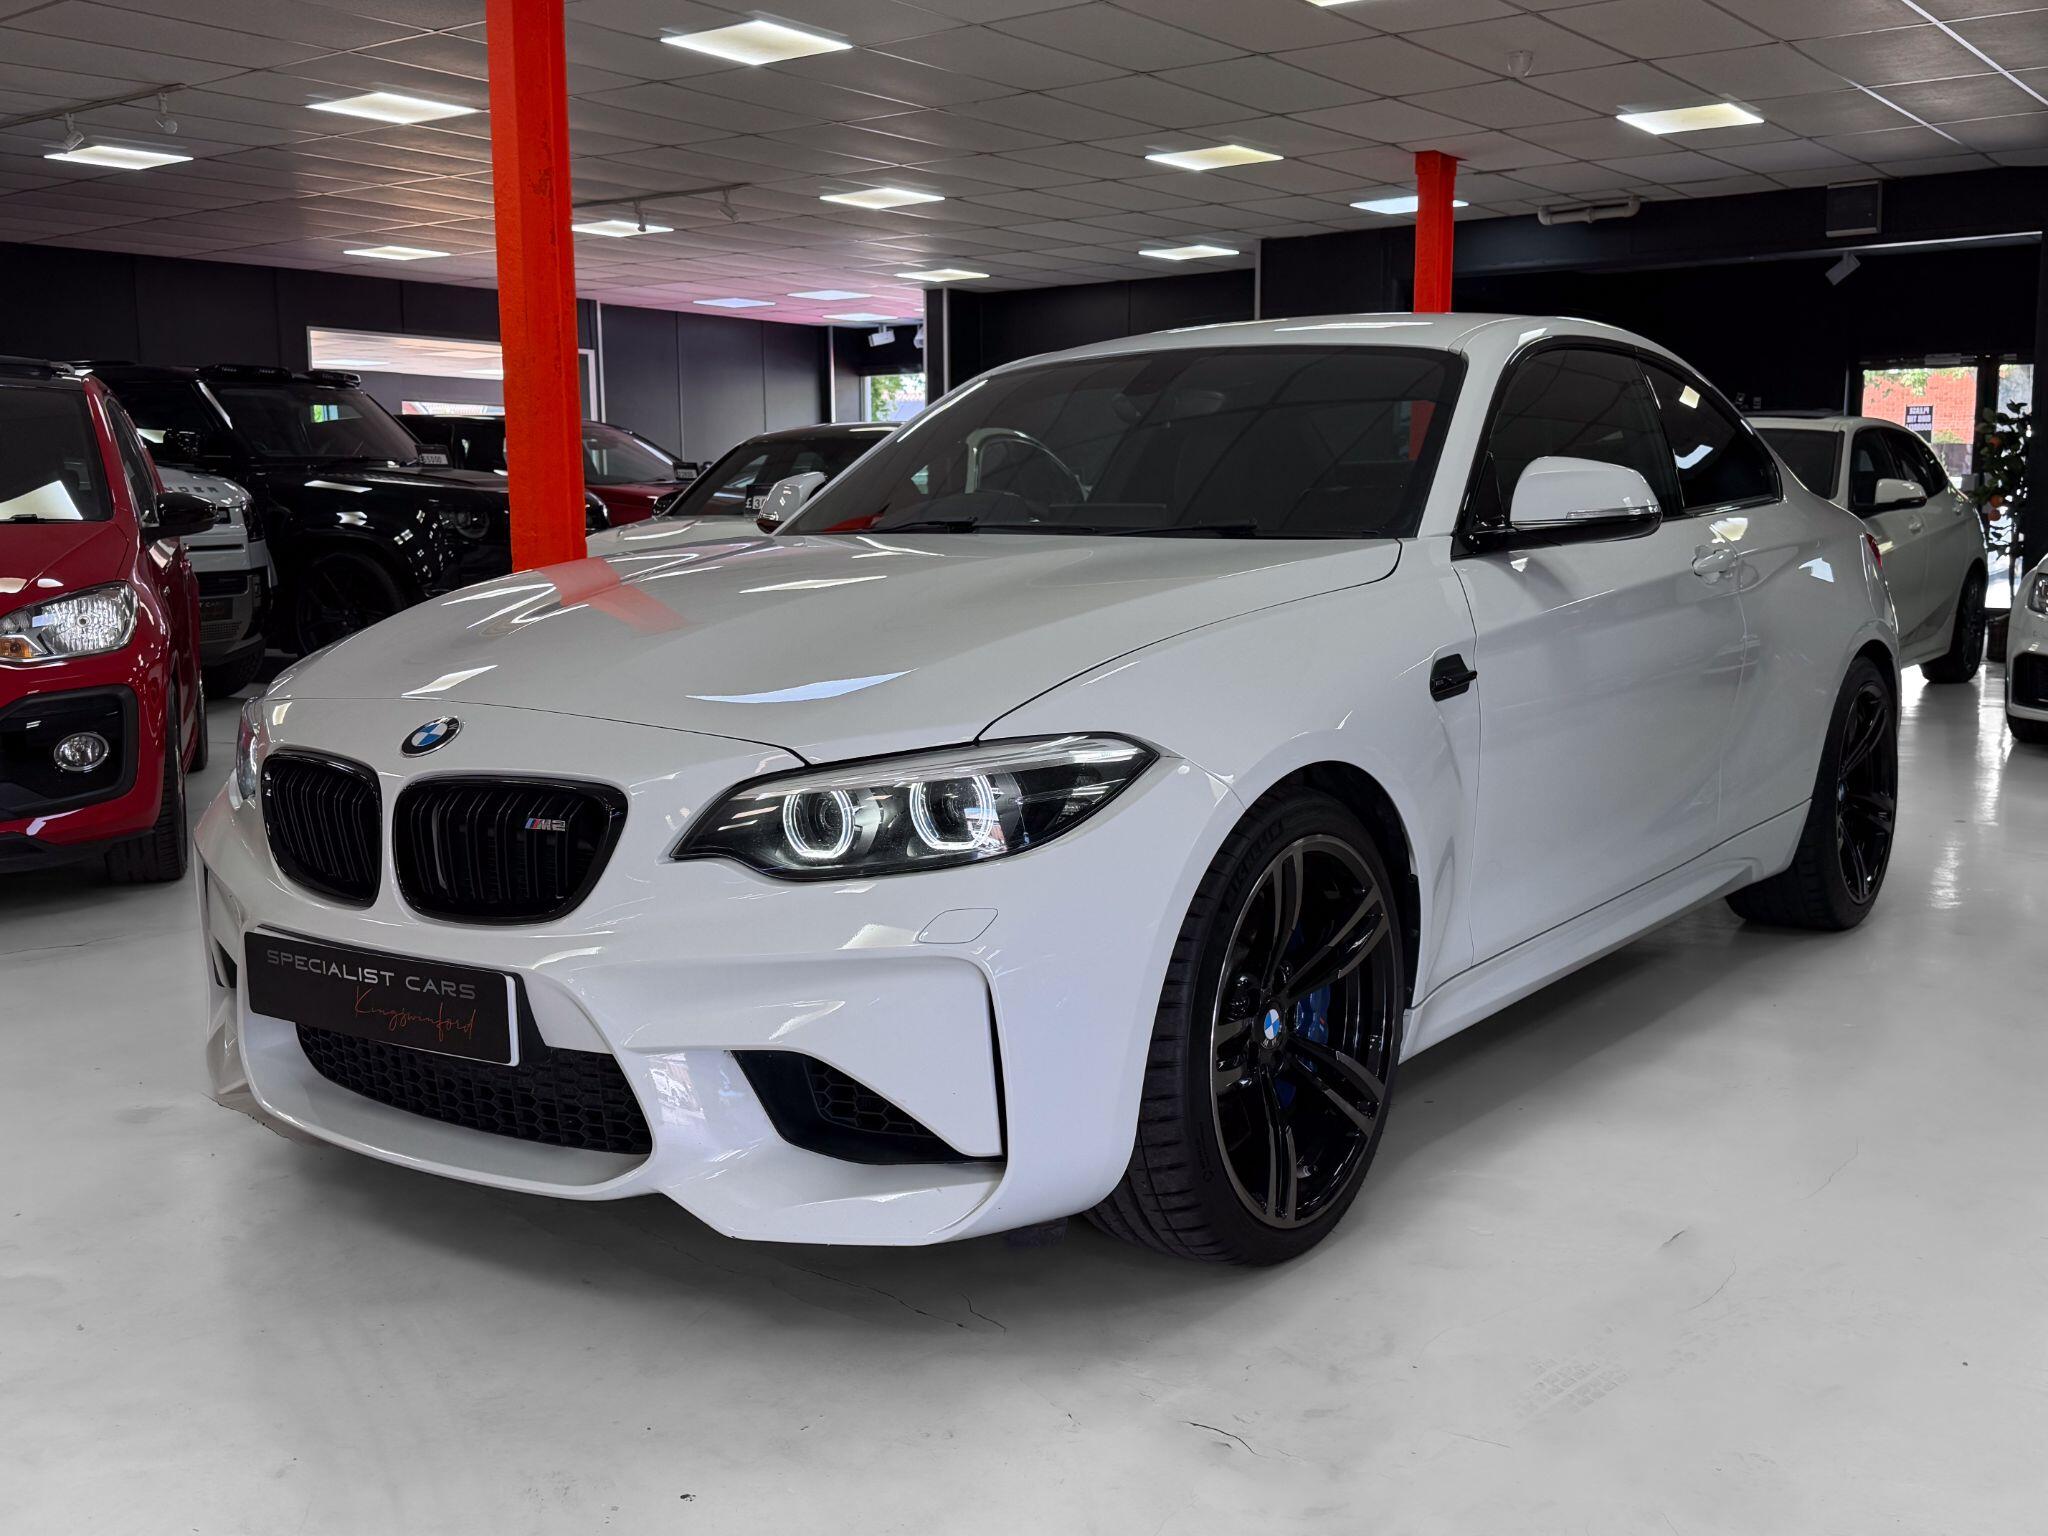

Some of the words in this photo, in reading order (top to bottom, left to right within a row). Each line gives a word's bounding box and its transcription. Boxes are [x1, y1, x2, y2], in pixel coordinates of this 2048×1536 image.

[529, 818, 566, 831] M2
[266, 950, 394, 987] SPECIALIST
[405, 975, 476, 1000] CARS
